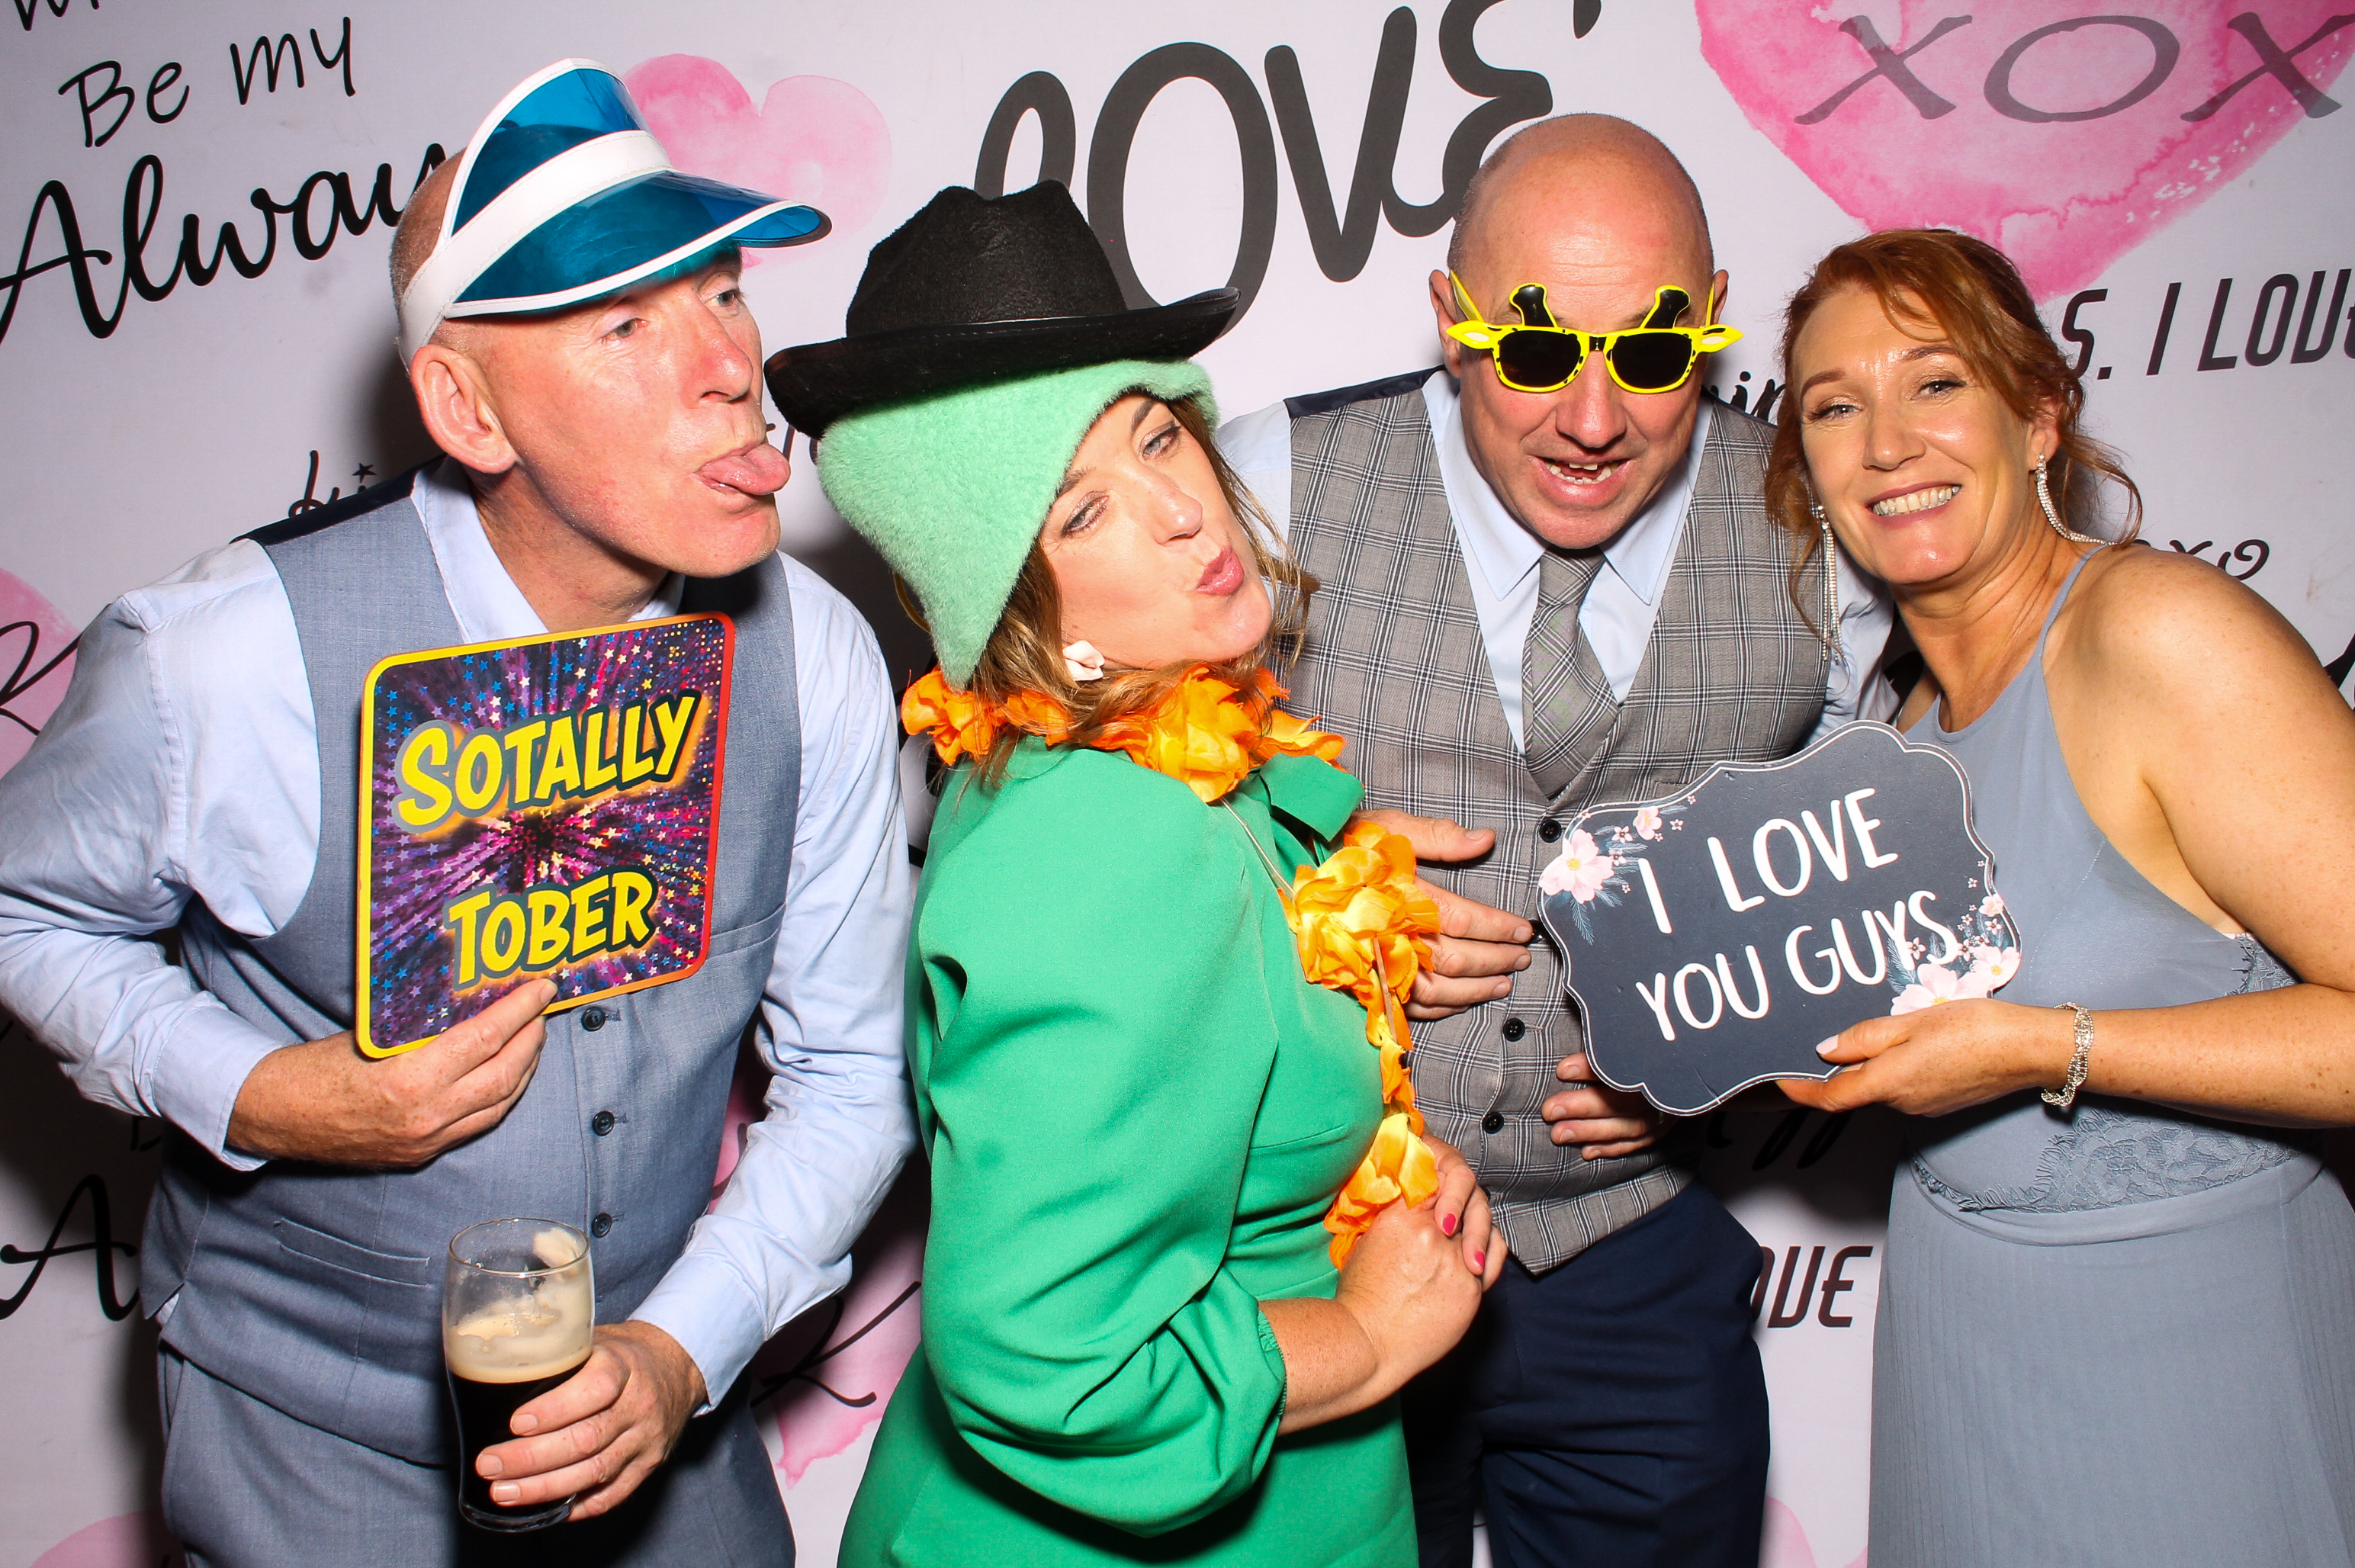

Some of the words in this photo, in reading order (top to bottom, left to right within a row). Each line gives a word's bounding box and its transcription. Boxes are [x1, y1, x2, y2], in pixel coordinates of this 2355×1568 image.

[58, 60, 190, 148] Be
[2146, 281, 2182, 376] I
[2196, 268, 2355, 372] LOV
[397, 695, 696, 827] SOTALLY
[1637, 857, 1672, 934] I
[1707, 788, 1899, 912] LOVE
[448, 871, 654, 984] TOBER
[1635, 945, 1769, 1042] YOU
[1785, 890, 1958, 994] GUYS
[1751, 1245, 1874, 1329] OVE
